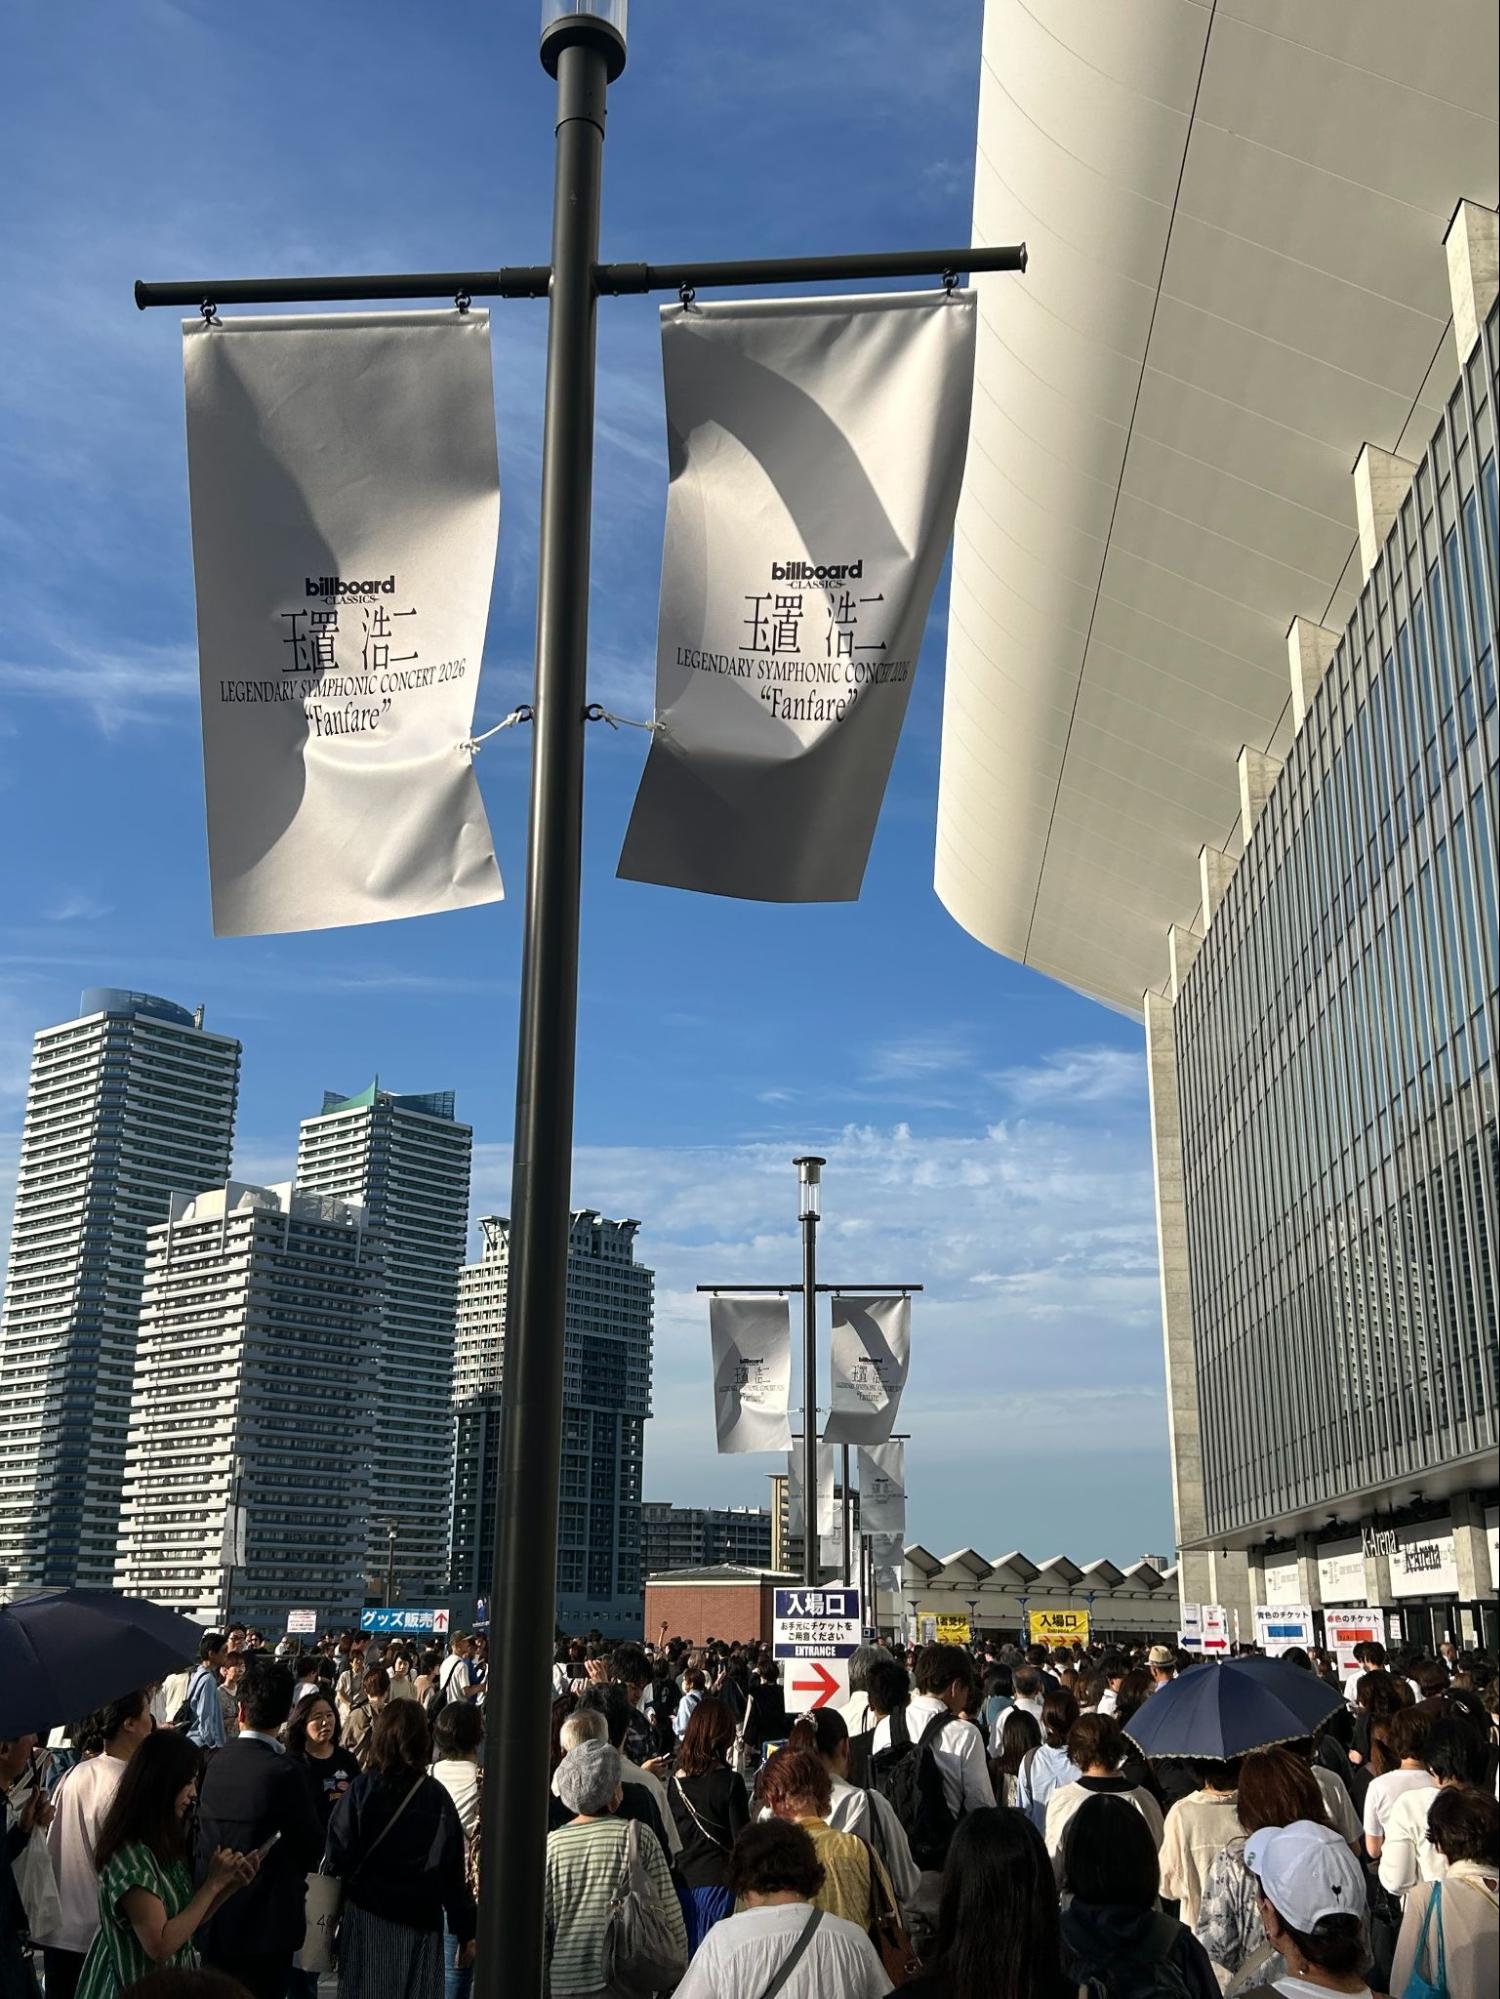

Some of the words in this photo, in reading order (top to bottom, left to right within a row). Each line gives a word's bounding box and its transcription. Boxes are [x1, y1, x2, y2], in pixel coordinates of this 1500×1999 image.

[771, 560, 863, 581] billboard
[305, 575, 395, 596] billboard
[787, 580, 846, 589] CLASSICS
[322, 594, 377, 605] CLASSICS
[738, 592, 804, 656] 玉置
[825, 590, 887, 658] 浩二
[281, 608, 340, 674] 玉置
[361, 605, 419, 671] 浩二
[676, 647, 755, 678] LEGENDARY
[756, 660, 842, 683] SYMPHONIC
[844, 661, 895, 684] CONC
[220, 680, 298, 702] LEGENDARY
[299, 675, 378, 698] SYMPHONIC
[380, 666, 437, 693] CONCERT
[437, 658, 466, 683] 2026
[1361, 1526, 1398, 1557] K-Arena
[787, 1592, 845, 1616] 入場口
[362, 1611, 433, 1629] グッズ販売
[780, 1621, 853, 1631] お手元にチケットを
[1040, 1614, 1077, 1627] 入場口
[788, 1632, 845, 1641] ご用意ください
[795, 1646, 836, 1657] ENTRANCE
